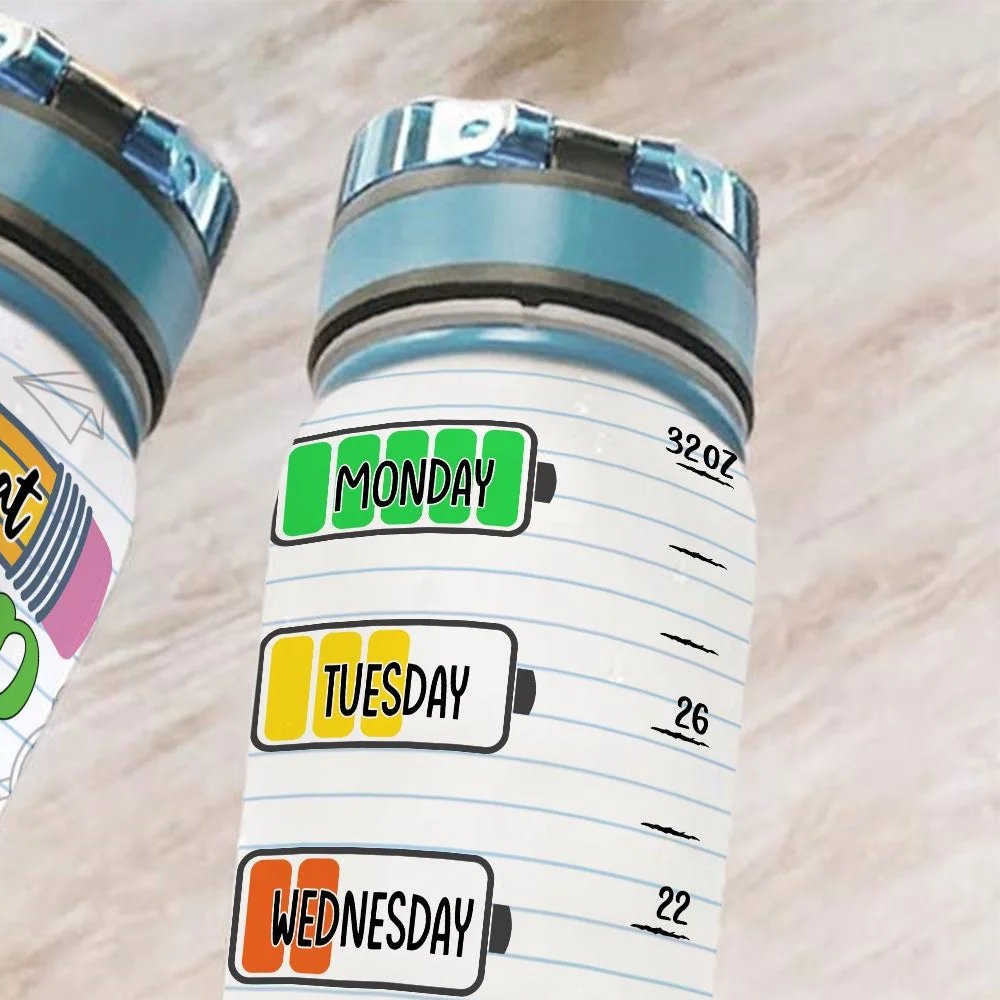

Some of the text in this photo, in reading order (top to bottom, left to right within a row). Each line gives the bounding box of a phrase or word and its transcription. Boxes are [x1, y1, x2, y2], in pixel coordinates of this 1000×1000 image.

[333, 458, 496, 513] MONDAY
[324, 662, 470, 720] TUESDAY
[674, 696, 710, 736] 26
[270, 889, 475, 958] WEDNESDAY
[656, 885, 690, 926] 22
